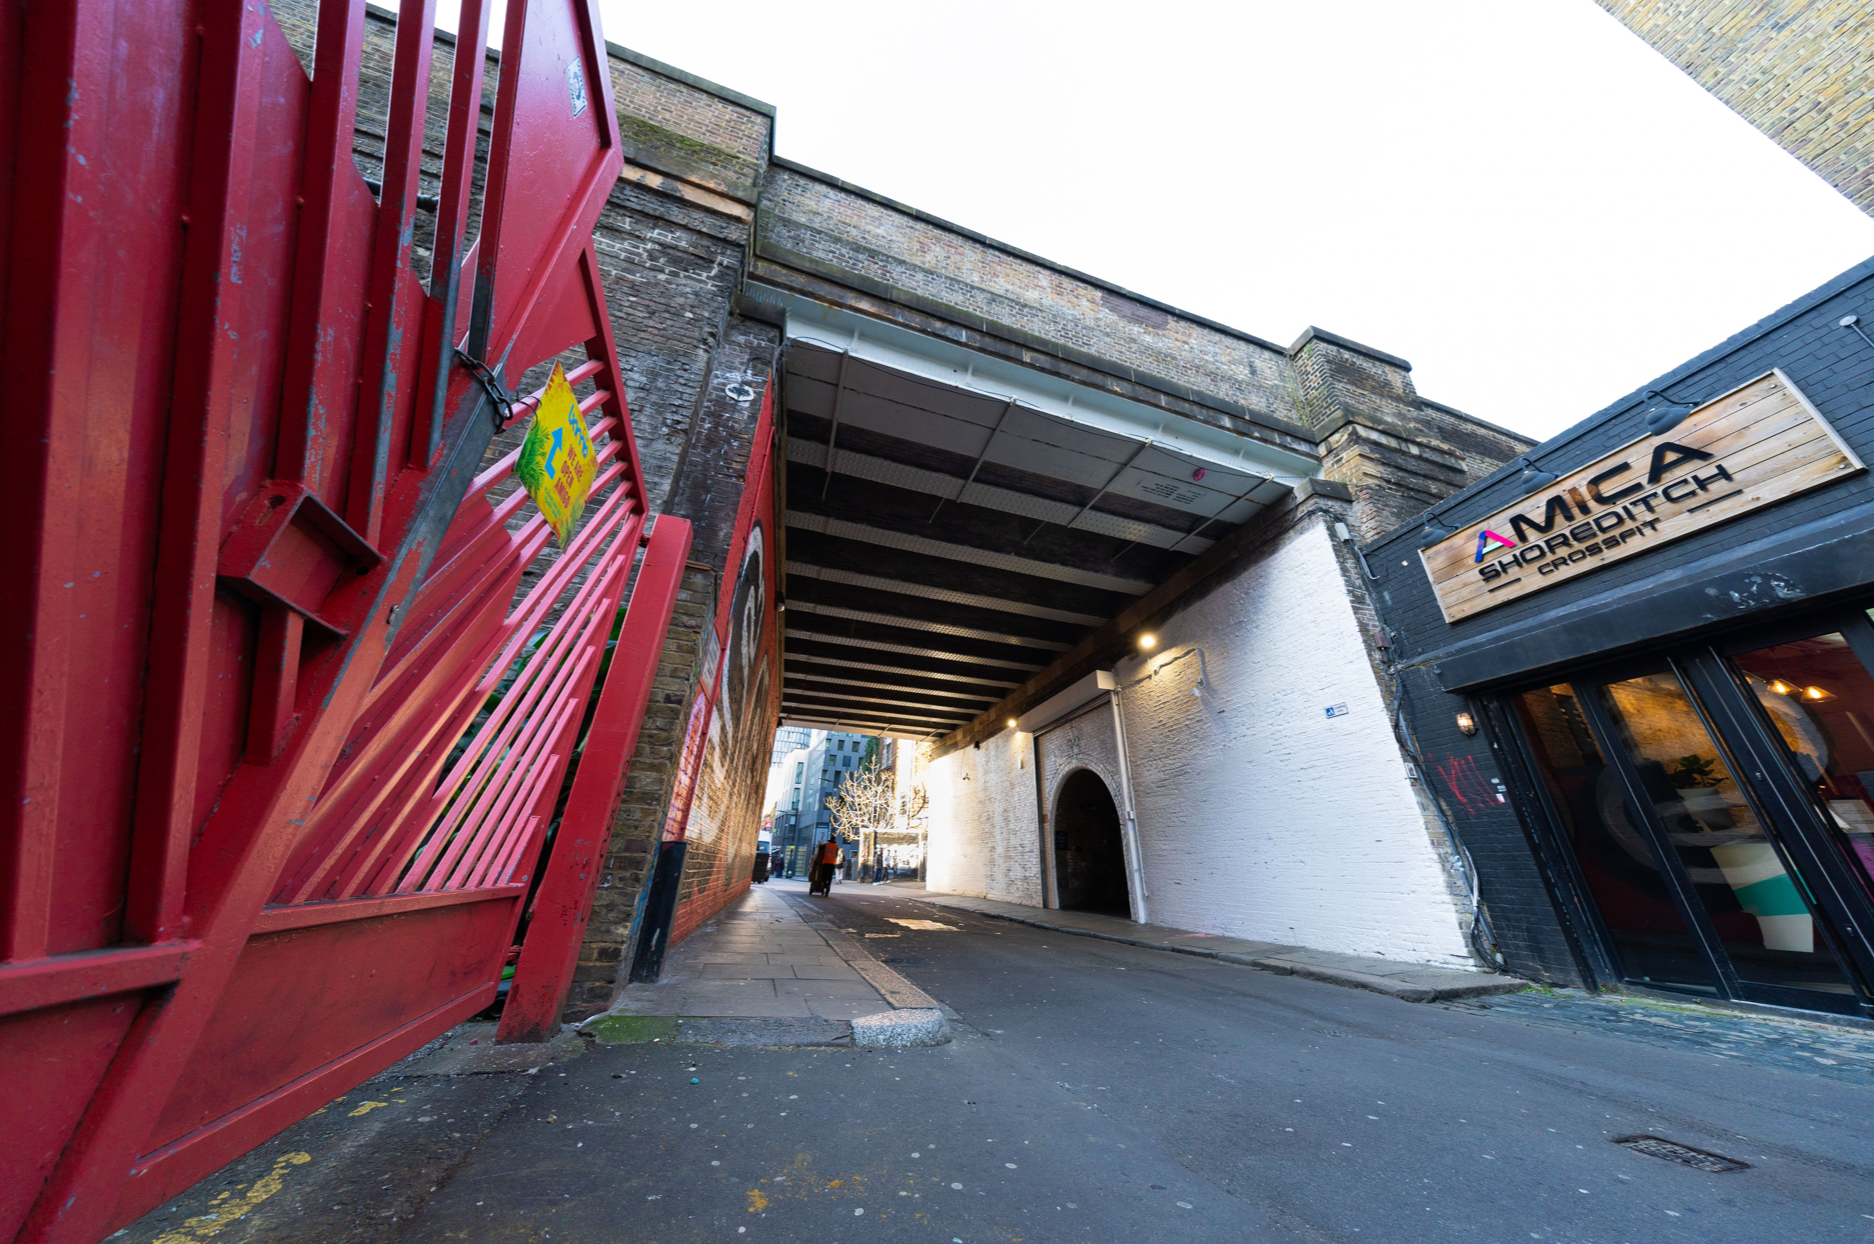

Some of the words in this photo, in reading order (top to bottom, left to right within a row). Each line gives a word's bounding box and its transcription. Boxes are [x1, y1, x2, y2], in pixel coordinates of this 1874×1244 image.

[561, 460, 574, 489] OPEN
[567, 443, 577, 467] WE
[573, 460, 584, 483] ARE
[554, 477, 571, 509] AMIGO
[1474, 441, 1716, 563] AMICA
[1478, 463, 1733, 583] SHOREDITCH
[1537, 517, 1661, 576] CROSSFIT
